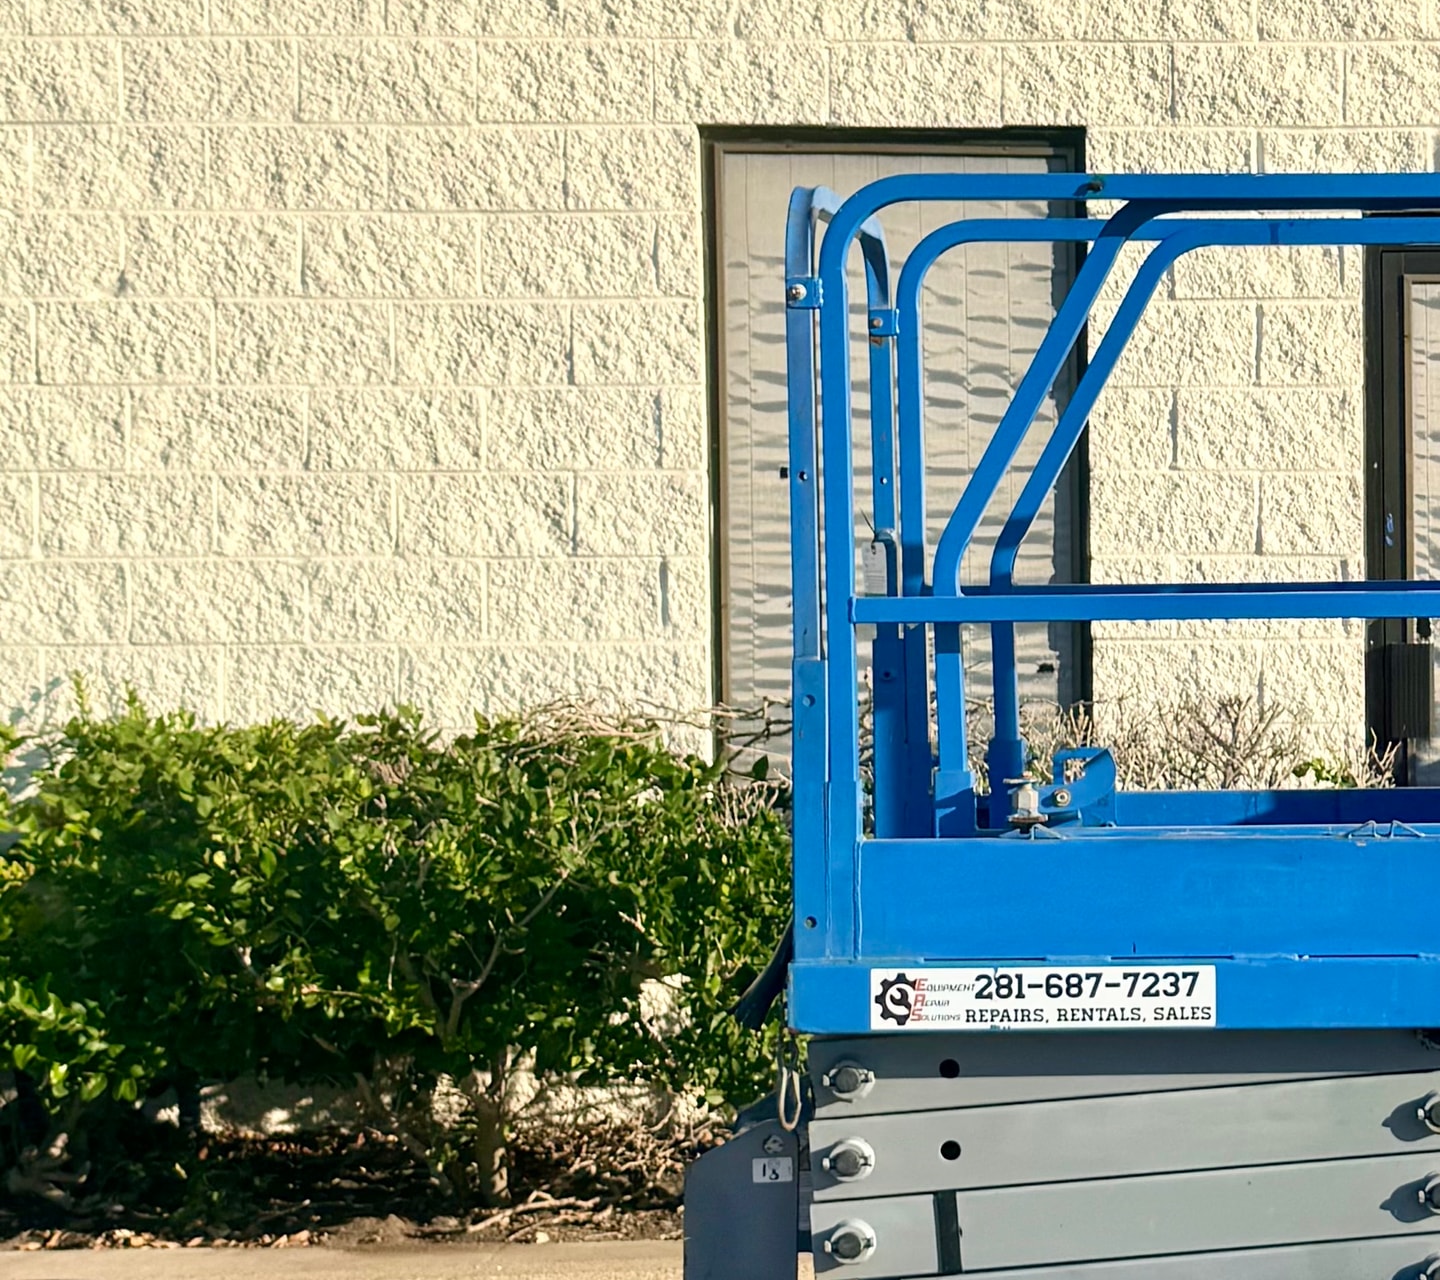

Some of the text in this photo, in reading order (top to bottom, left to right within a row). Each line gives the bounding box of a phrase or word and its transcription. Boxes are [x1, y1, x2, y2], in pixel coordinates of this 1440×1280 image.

[974, 972, 1199, 1000] 281-687-7237
[965, 1005, 1212, 1024] REPAIRS, RENTALS, SALES
